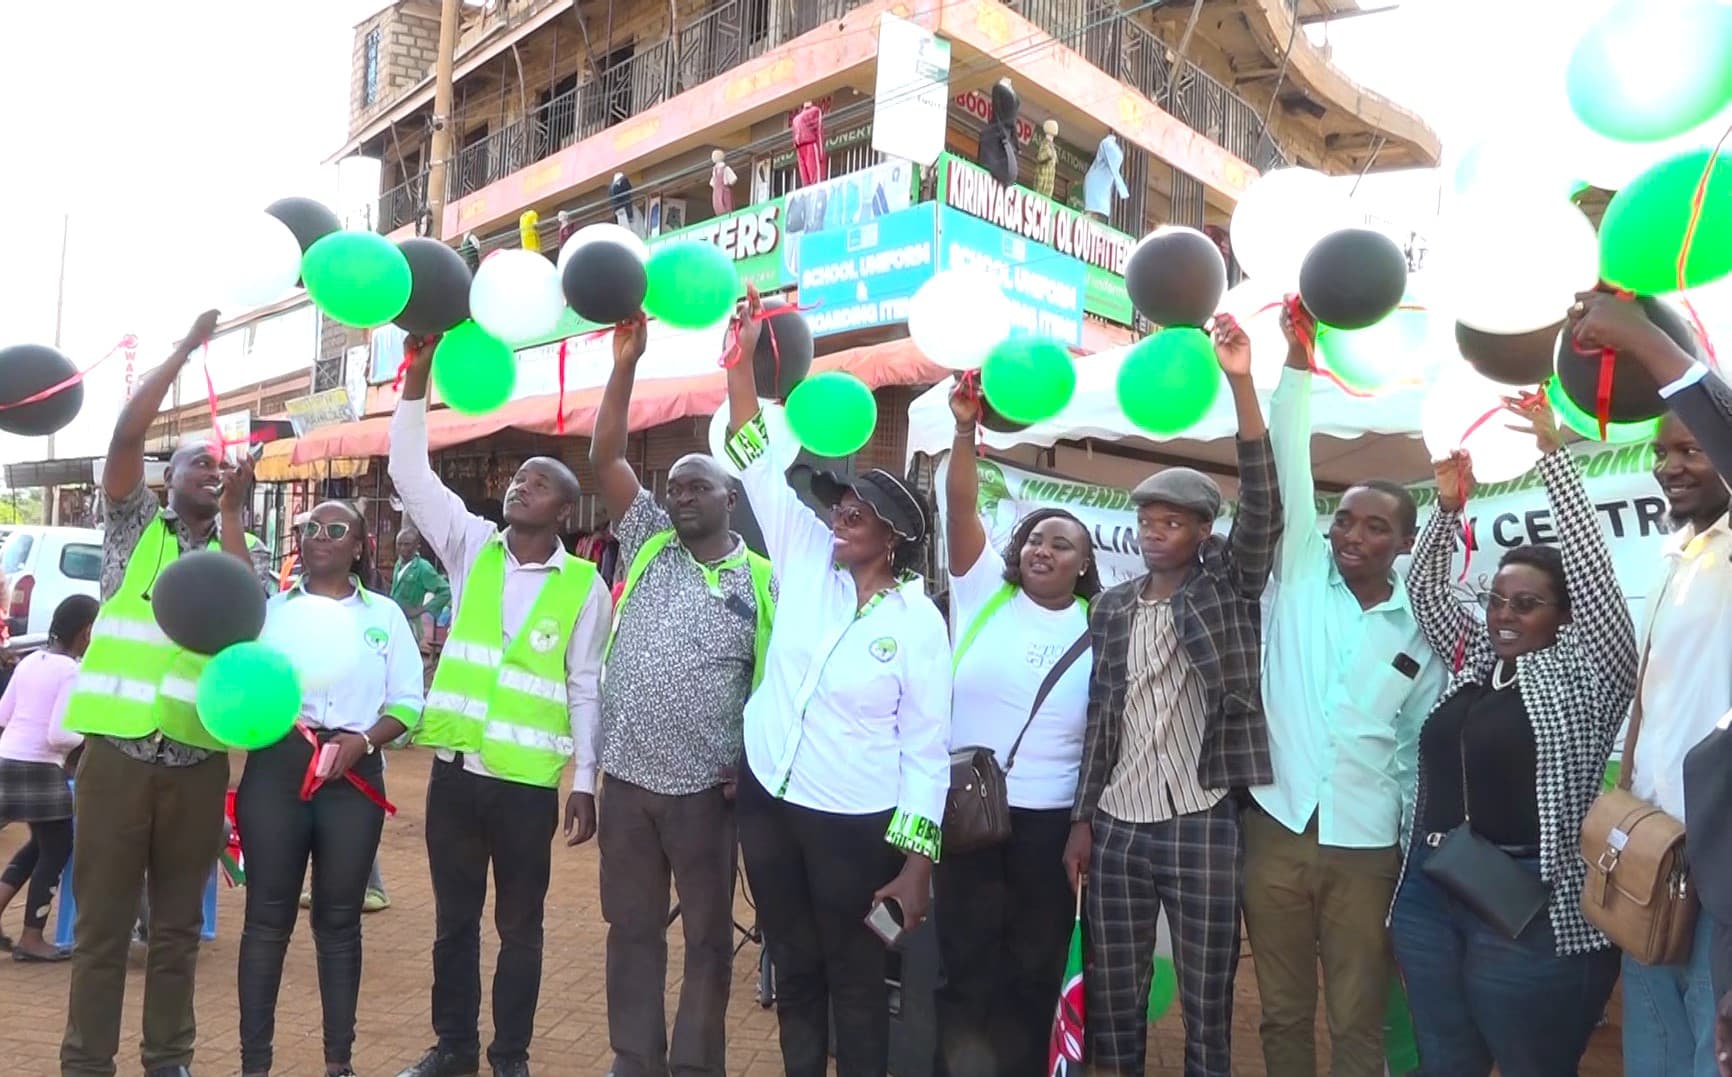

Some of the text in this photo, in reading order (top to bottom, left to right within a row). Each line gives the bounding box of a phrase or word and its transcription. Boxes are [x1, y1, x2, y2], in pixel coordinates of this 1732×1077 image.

[947, 159, 1024, 234] KIRINYAGA
[1022, 193, 1072, 253] SCHOL
[802, 258, 859, 288] SCHOOL
[859, 241, 931, 277] UNIFORM
[1493, 496, 1668, 548] CETR
